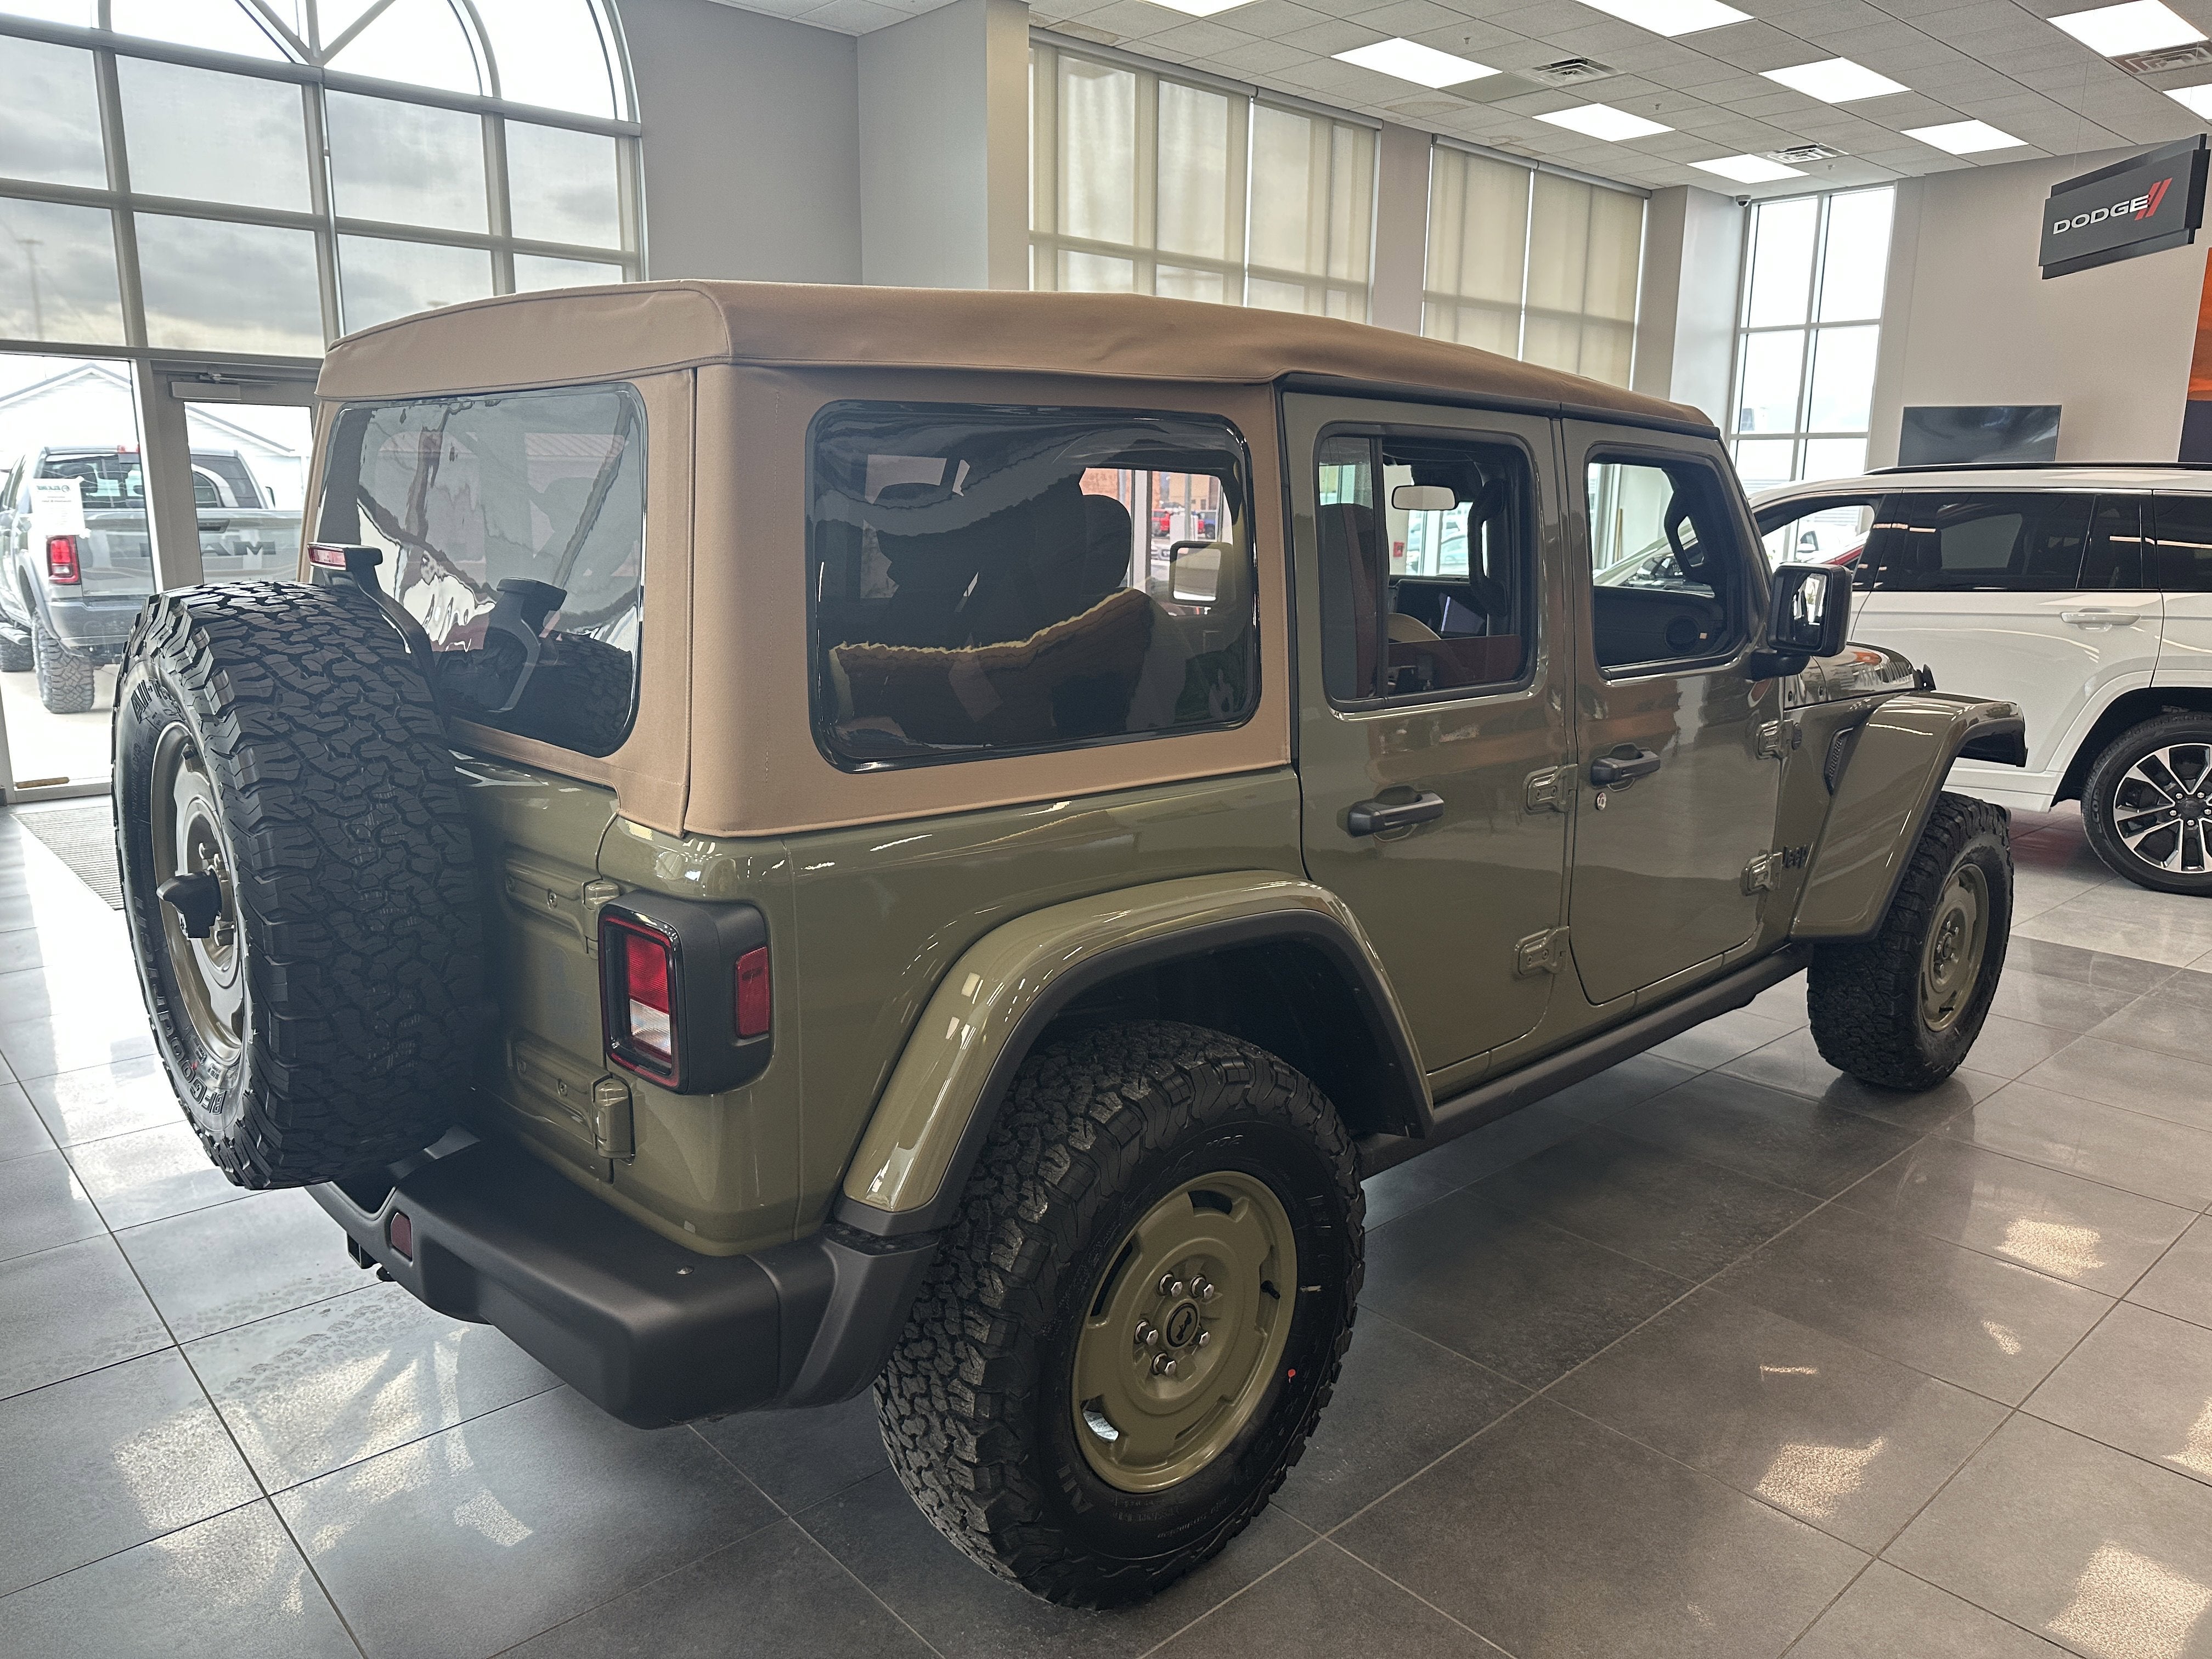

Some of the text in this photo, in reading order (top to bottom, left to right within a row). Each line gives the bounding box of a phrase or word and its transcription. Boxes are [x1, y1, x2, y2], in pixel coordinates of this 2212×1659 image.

[2052, 194, 2150, 235] DODGE
[139, 540, 276, 557] AM
[1782, 845, 1808, 870] Jeep
